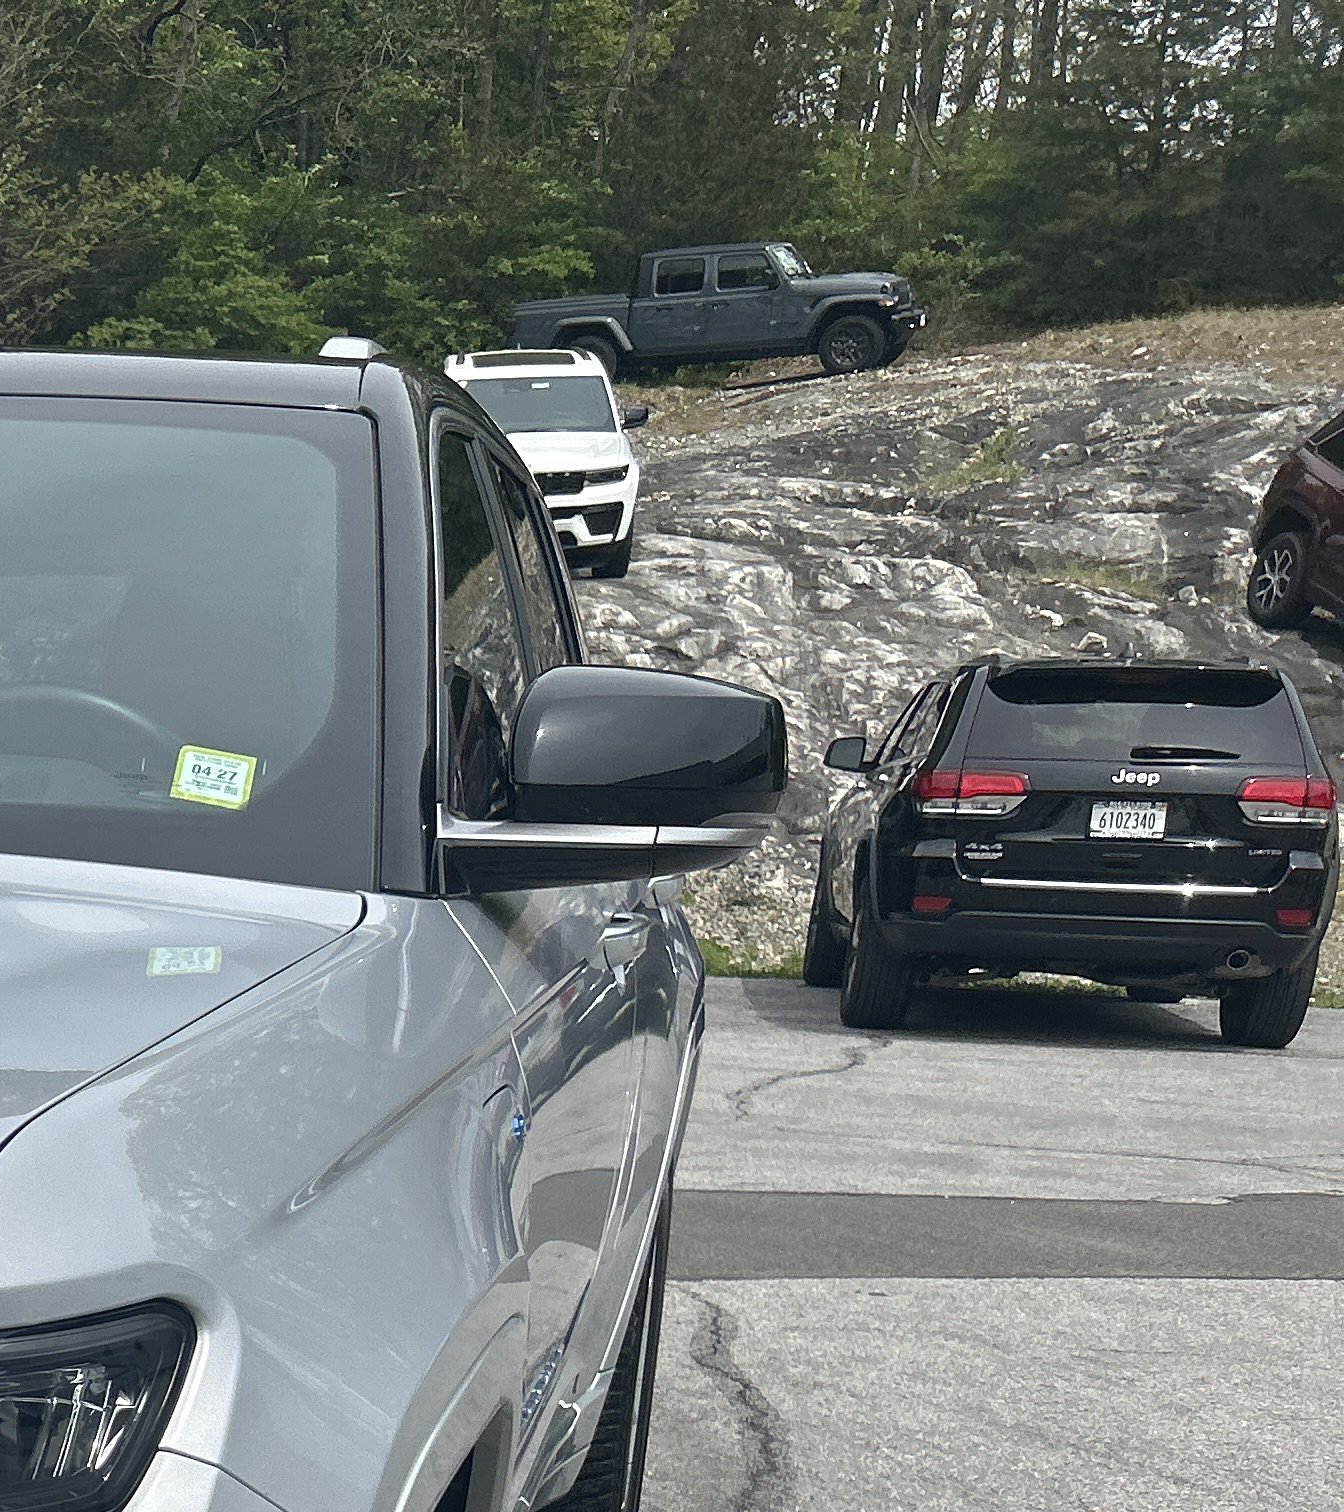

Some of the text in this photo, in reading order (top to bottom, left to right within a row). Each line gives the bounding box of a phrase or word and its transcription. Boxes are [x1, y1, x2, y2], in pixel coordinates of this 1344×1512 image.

[191, 763, 212, 777] 04
[216, 768, 239, 781] 27
[1111, 768, 1161, 787] Jeep
[1099, 811, 1156, 830] 6102340
